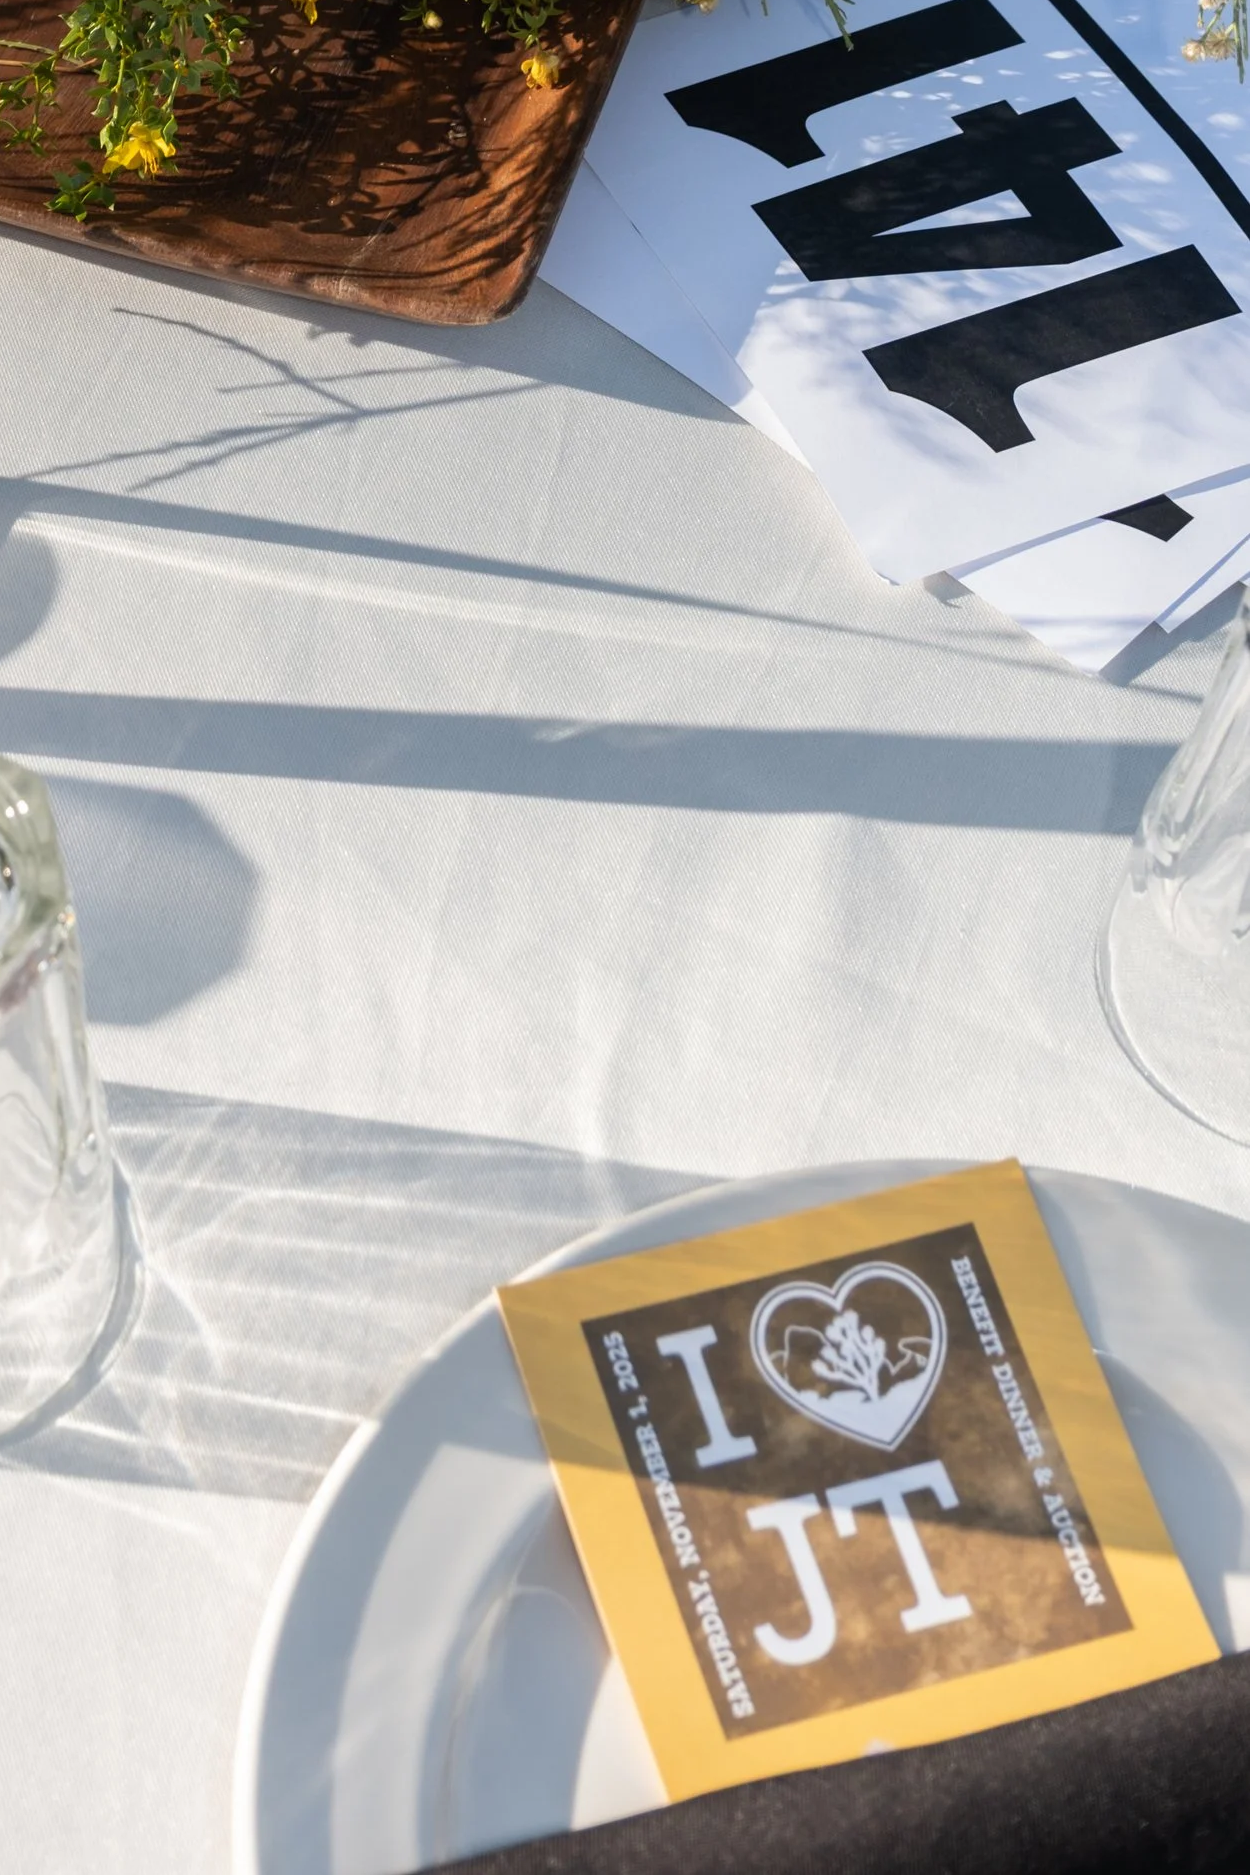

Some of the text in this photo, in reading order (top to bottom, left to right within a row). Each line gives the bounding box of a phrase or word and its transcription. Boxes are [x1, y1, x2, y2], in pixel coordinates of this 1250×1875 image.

[603, 1331, 755, 1719] SATURDAY, NOVEMBER 1, 2025
[656, 1325, 758, 1469] I
[951, 1256, 1106, 1607] BENEFIT DINNER & AUCTION
[747, 1459, 974, 1666] JT
